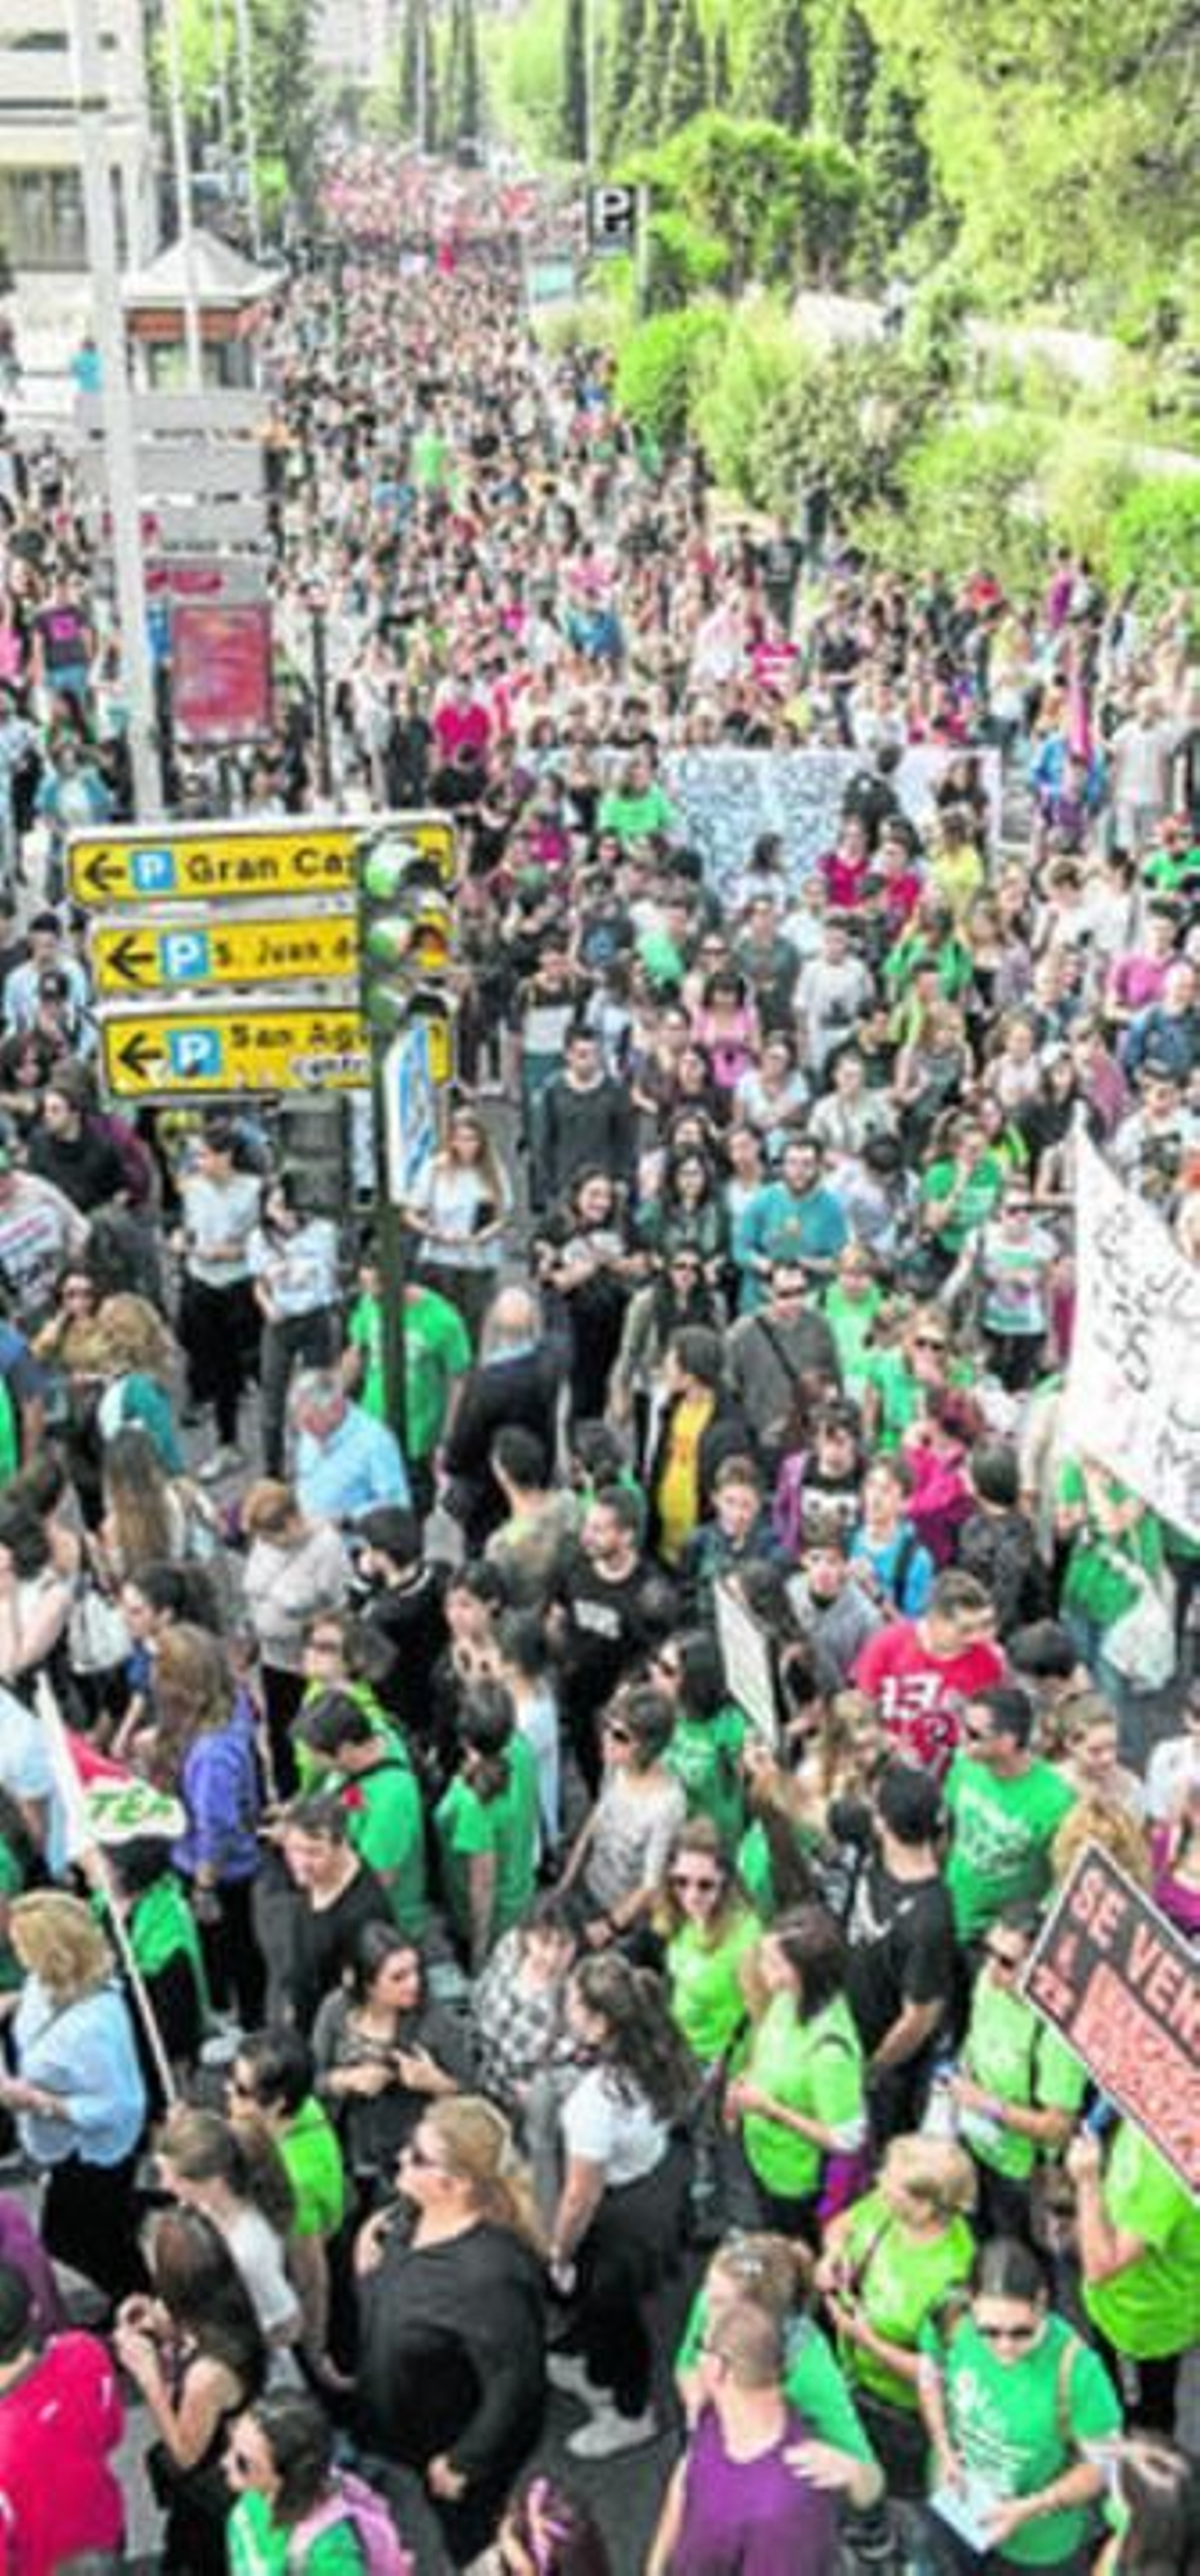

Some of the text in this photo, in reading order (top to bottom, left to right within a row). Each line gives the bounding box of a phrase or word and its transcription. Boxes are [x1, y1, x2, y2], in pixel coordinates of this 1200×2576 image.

[593, 188, 630, 233] P
[186, 854, 278, 883] Gran
[167, 935, 200, 977] P
[257, 935, 320, 968] Juan
[176, 1034, 210, 1071] P
[230, 1022, 292, 1049] San
[1070, 1866, 1127, 1952] SE
